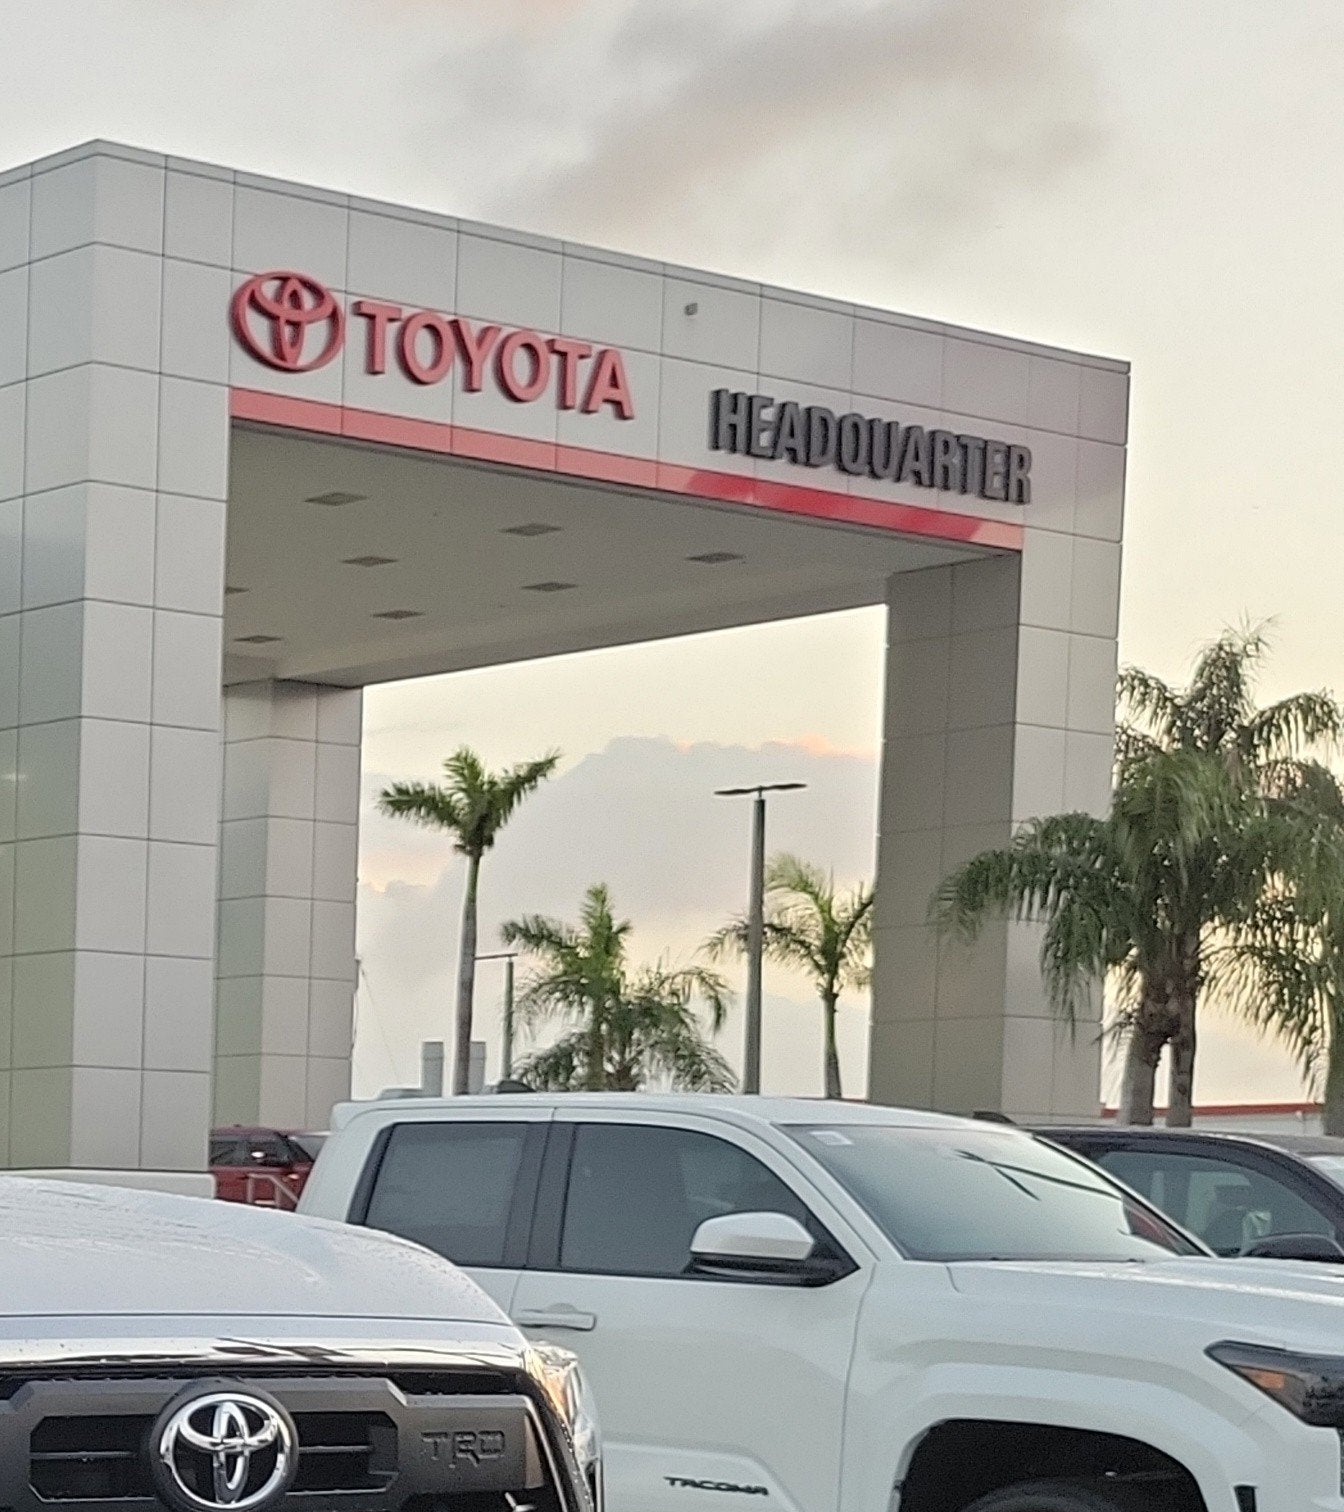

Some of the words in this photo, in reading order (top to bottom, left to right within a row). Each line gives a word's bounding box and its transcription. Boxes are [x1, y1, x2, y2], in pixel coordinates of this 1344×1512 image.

[353, 299, 635, 421] TOYOTA
[709, 388, 1033, 505] HEADQUARTER
[421, 1430, 505, 1468] TRD
[663, 1476, 769, 1496] TACOMA
